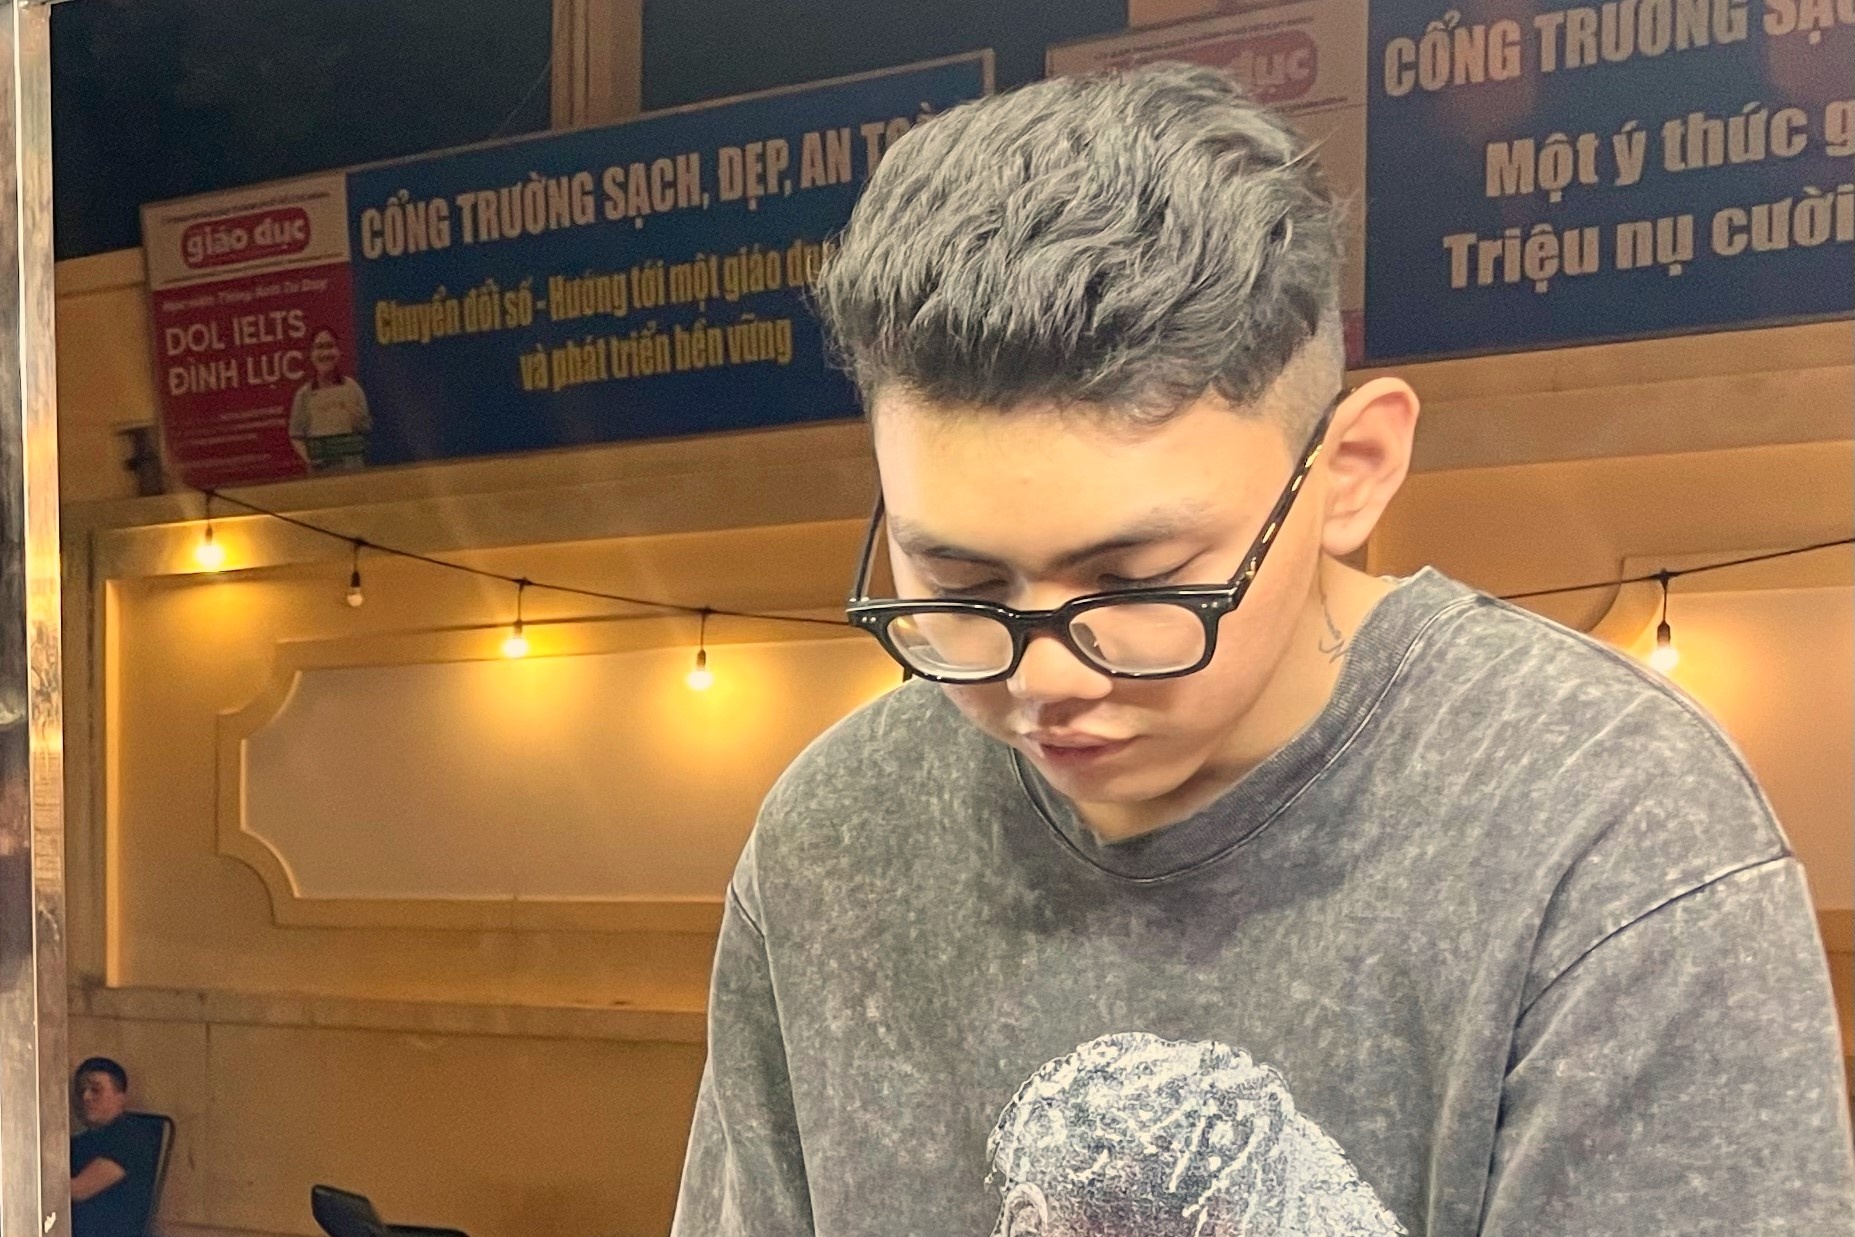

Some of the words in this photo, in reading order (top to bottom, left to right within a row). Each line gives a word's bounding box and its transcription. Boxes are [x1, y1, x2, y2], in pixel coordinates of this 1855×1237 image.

[1383, 10, 1522, 98] CỔNG
[361, 188, 451, 260] CỔNG
[456, 171, 594, 244] TRƯỜNG
[603, 152, 710, 229] SẠCH,
[800, 127, 853, 189] AN
[1485, 132, 1600, 203] Một
[1612, 119, 1647, 187] ý
[1662, 100, 1809, 173] thức
[187, 225, 248, 264] giáo
[253, 217, 307, 250] dục
[1444, 223, 1600, 294] Triệu
[1616, 214, 1695, 277] nụ
[1711, 183, 1855, 257] cười
[504, 275, 533, 329] số
[670, 253, 719, 313] một
[723, 242, 782, 302] giáo
[165, 320, 226, 357] DOL
[232, 308, 307, 346] IELTS
[520, 342, 549, 391] và
[551, 335, 608, 393] phát
[611, 320, 671, 379] triển
[726, 313, 793, 365] vững
